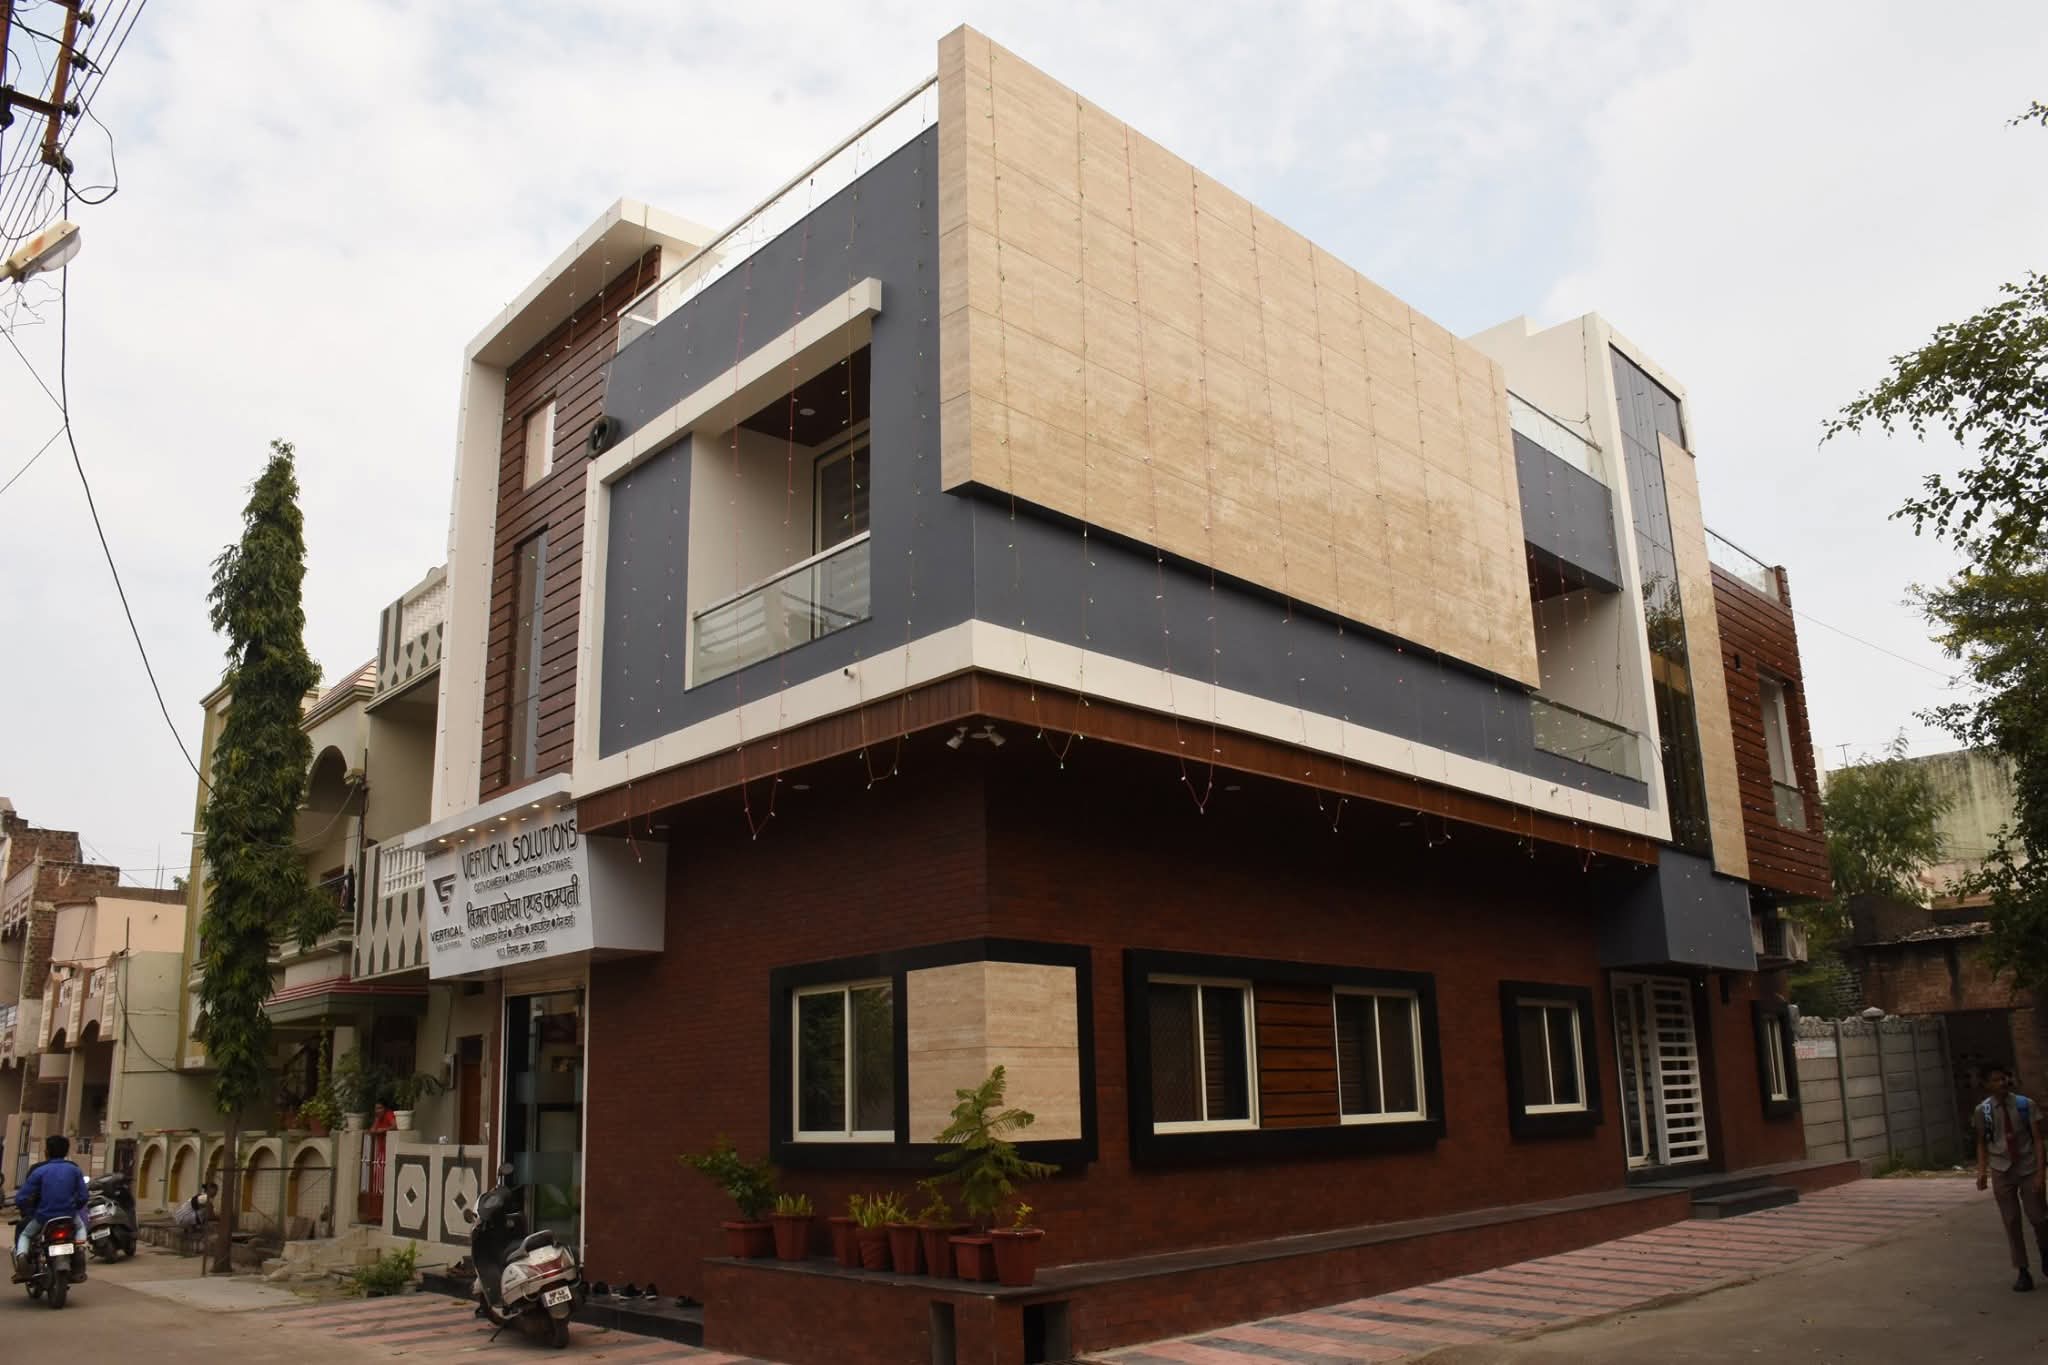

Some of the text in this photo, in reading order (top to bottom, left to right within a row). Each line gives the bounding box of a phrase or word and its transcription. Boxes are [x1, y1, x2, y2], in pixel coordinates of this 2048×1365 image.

[461, 819, 578, 879] VERTICAL SOLUTIONS
[509, 866, 537, 881] COMPUTER
[541, 856, 572, 873] SOFTWARE
[466, 901, 491, 930] विमल
[522, 891, 543, 920] एण्ड
[542, 873, 579, 911] कम्पनी
[431, 925, 463, 941] VERTICAL
